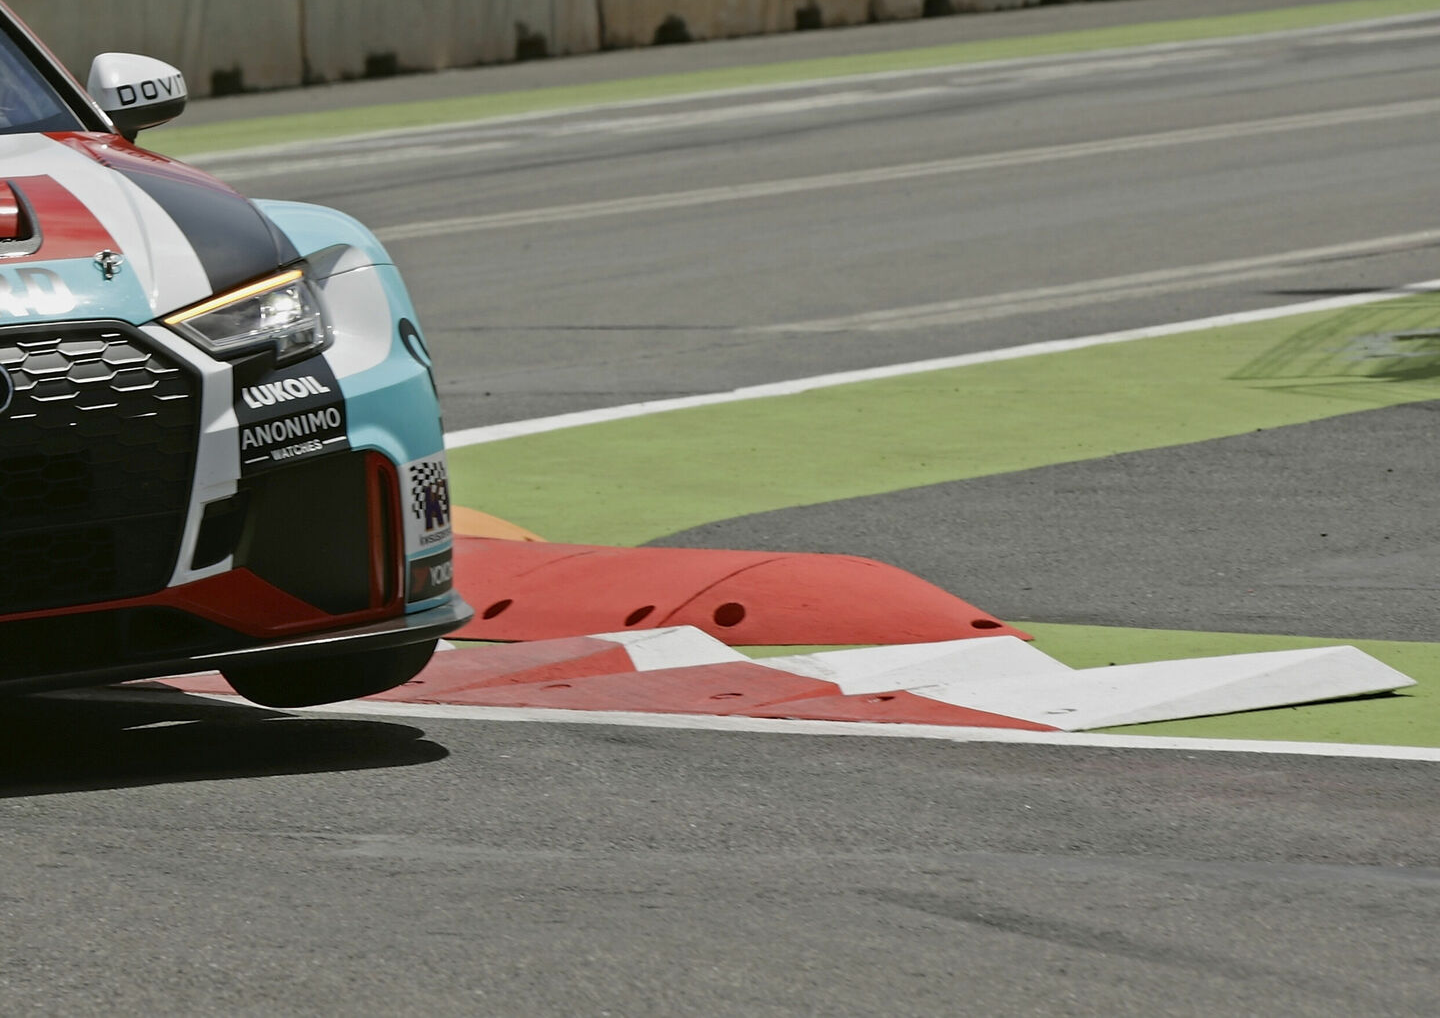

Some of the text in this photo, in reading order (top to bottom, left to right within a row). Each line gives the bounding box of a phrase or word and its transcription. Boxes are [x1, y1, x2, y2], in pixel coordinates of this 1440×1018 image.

[242, 375, 331, 409] LUKOIL
[242, 407, 341, 450] ANONIMO
[270, 439, 323, 461] WATCHES
